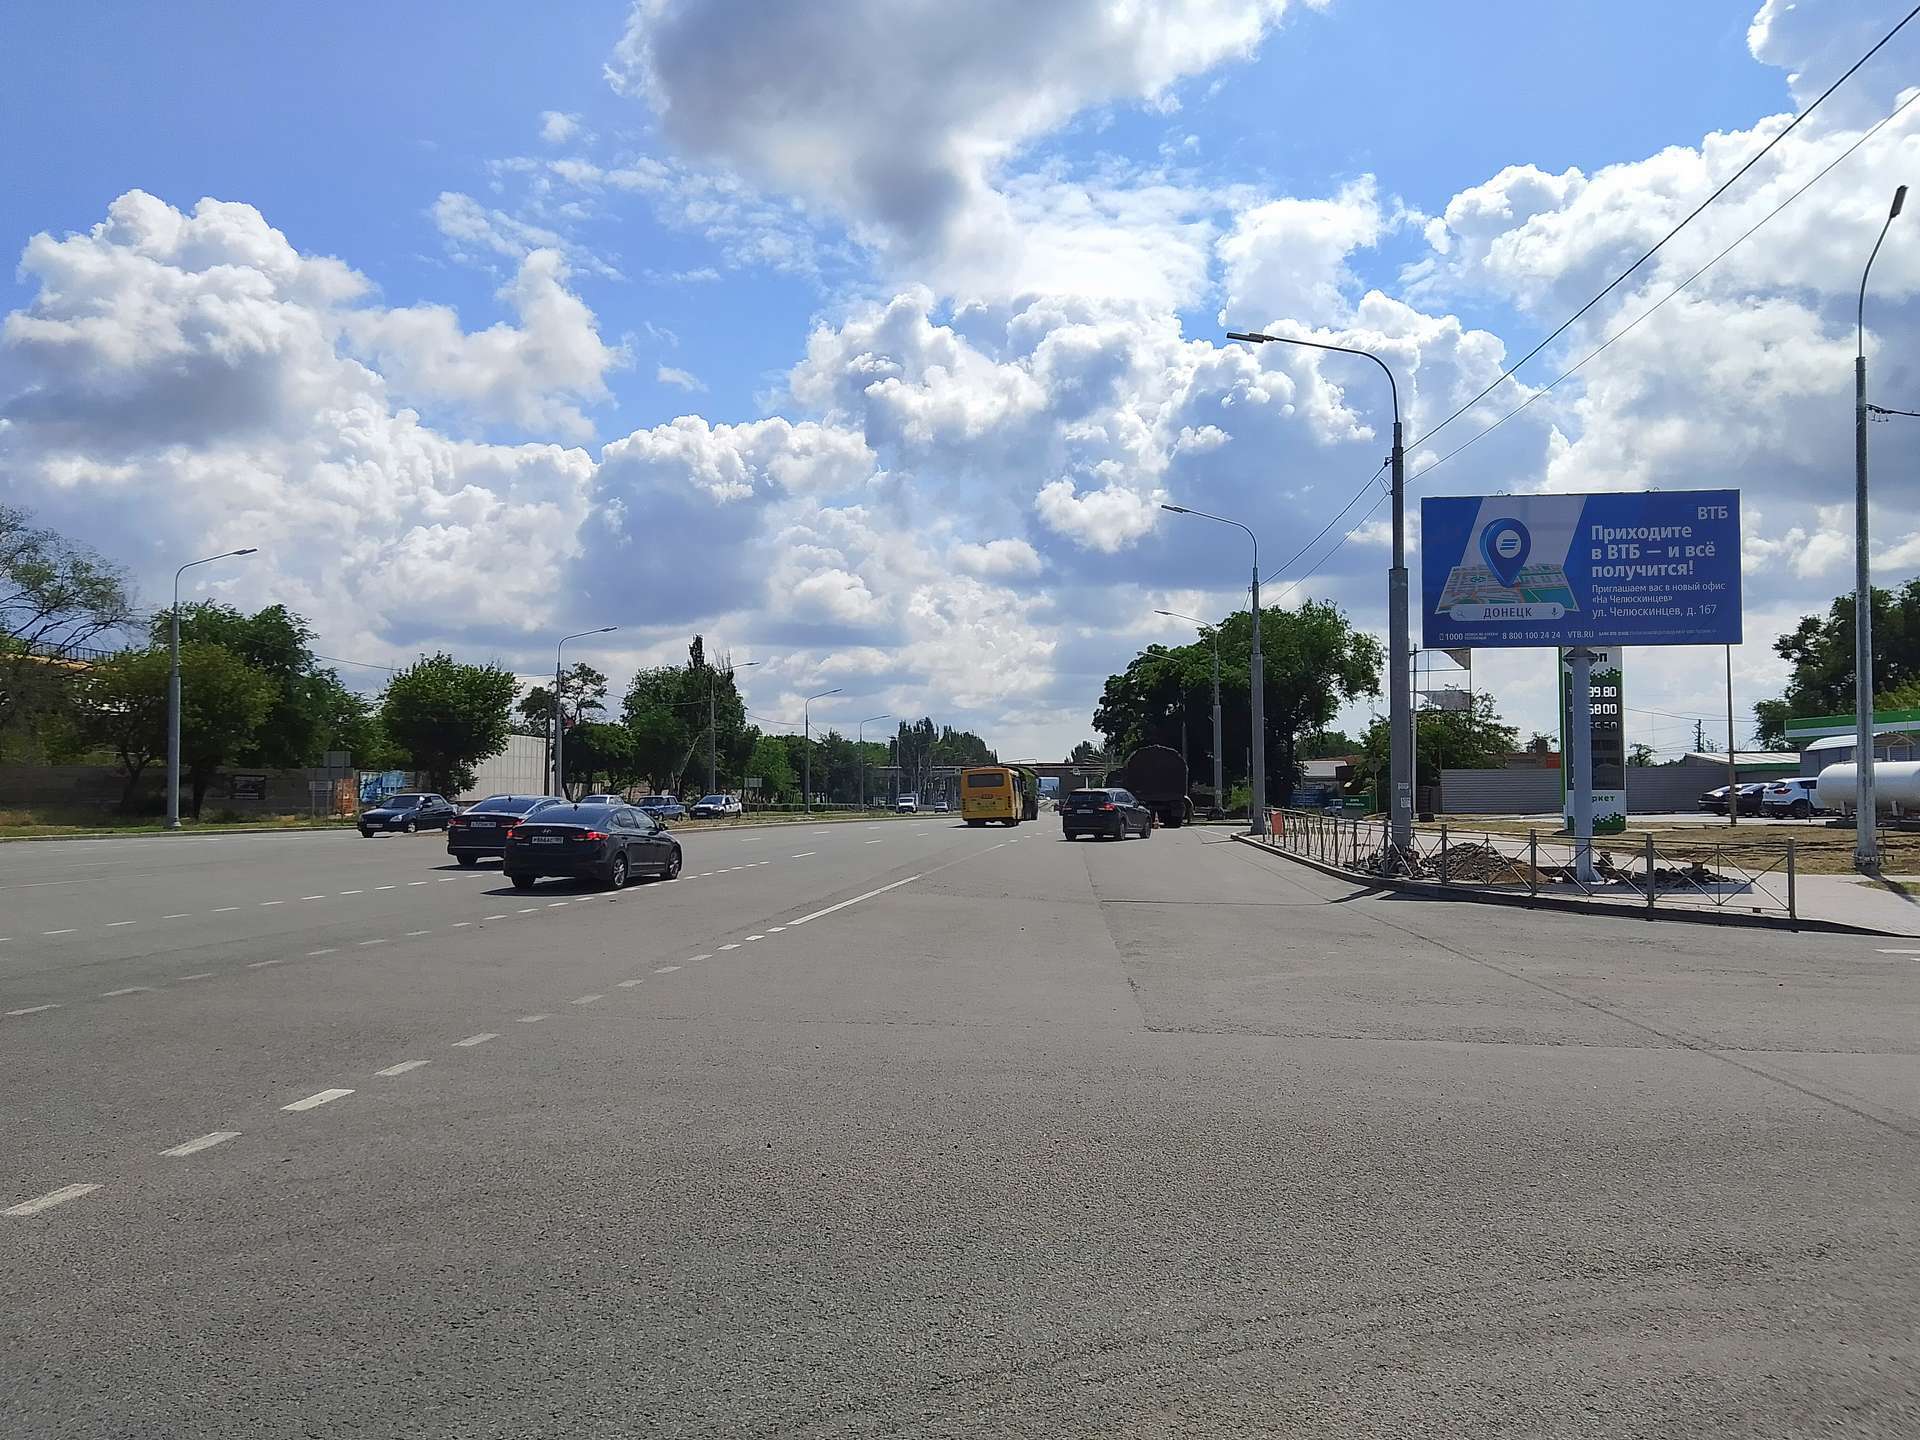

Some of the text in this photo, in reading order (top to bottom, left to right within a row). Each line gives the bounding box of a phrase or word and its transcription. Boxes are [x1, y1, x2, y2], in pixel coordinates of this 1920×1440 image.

[1697, 505, 1728, 520] ВТБ
[1591, 525, 1692, 544] Приходите
[1591, 548, 1602, 560] в
[1607, 543, 1640, 560] ВТБ
[1668, 545, 1679, 558] и
[1685, 541, 1716, 557] всё
[1592, 560, 1694, 581] получится!
[1592, 584, 1647, 594] Приглашаем
[1649, 584, 1663, 592] вас
[1672, 582, 1700, 591] новый
[1702, 581, 1726, 593] офис
[1592, 595, 1673, 604] «На Челюскинцев»
[1483, 607, 1532, 619] ДОНЕЦК
[1592, 604, 1718, 619] ул. Челюскинцев, д. 167
[1508, 632, 1523, 640] 800
[1551, 631, 1561, 639] 24
[1567, 631, 1594, 639] VTB.RU
